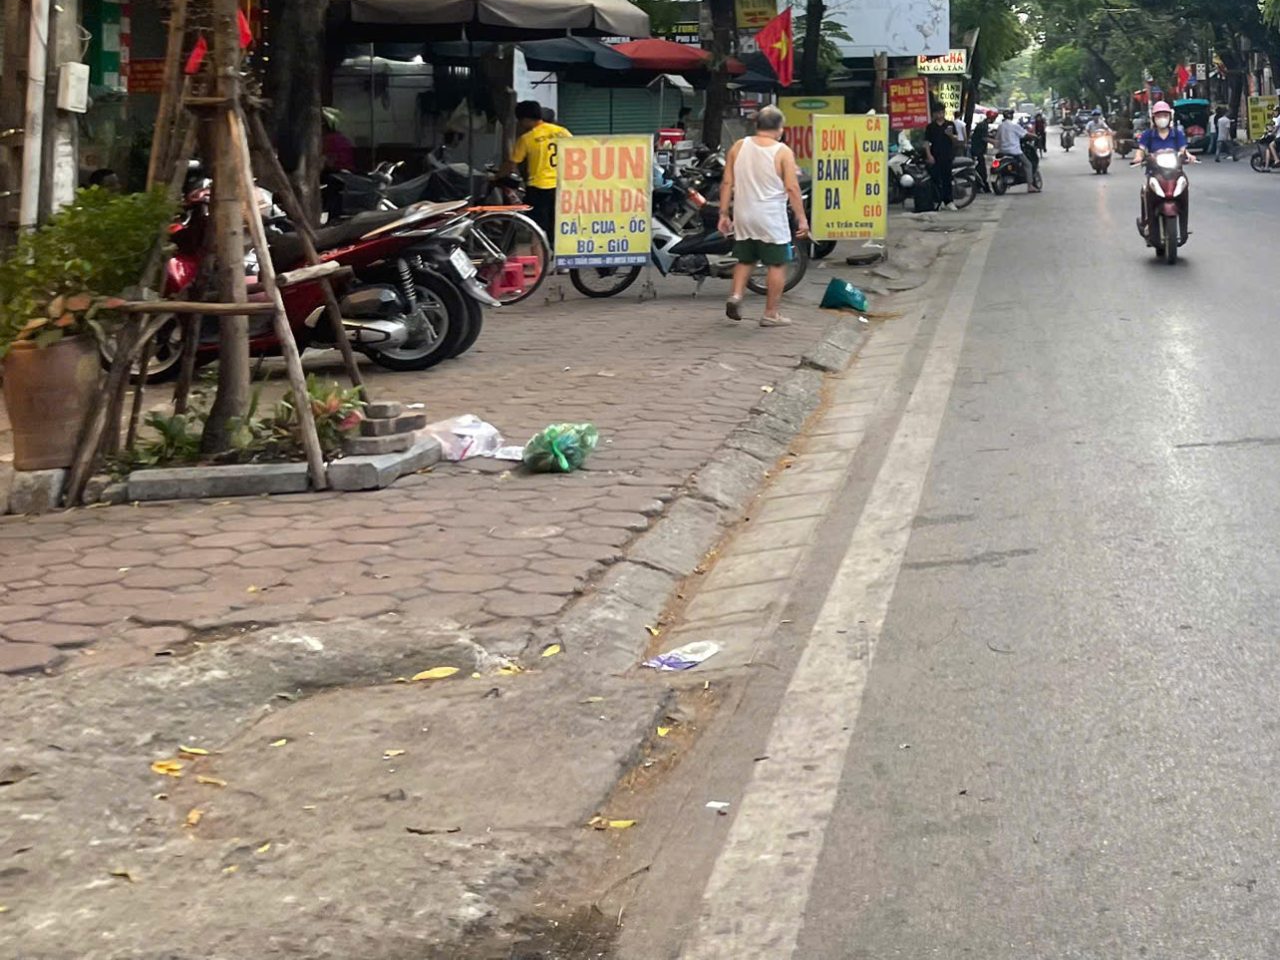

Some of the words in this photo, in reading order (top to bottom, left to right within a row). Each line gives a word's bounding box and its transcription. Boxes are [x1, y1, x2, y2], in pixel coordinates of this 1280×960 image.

[822, 125, 846, 152] BÚN
[863, 141, 884, 153] CUA
[817, 154, 850, 181] BÁNH
[561, 184, 614, 215] BÁNH
[620, 188, 646, 213] ĐA
[825, 188, 841, 210] ĐA
[592, 220, 616, 235] CUA
